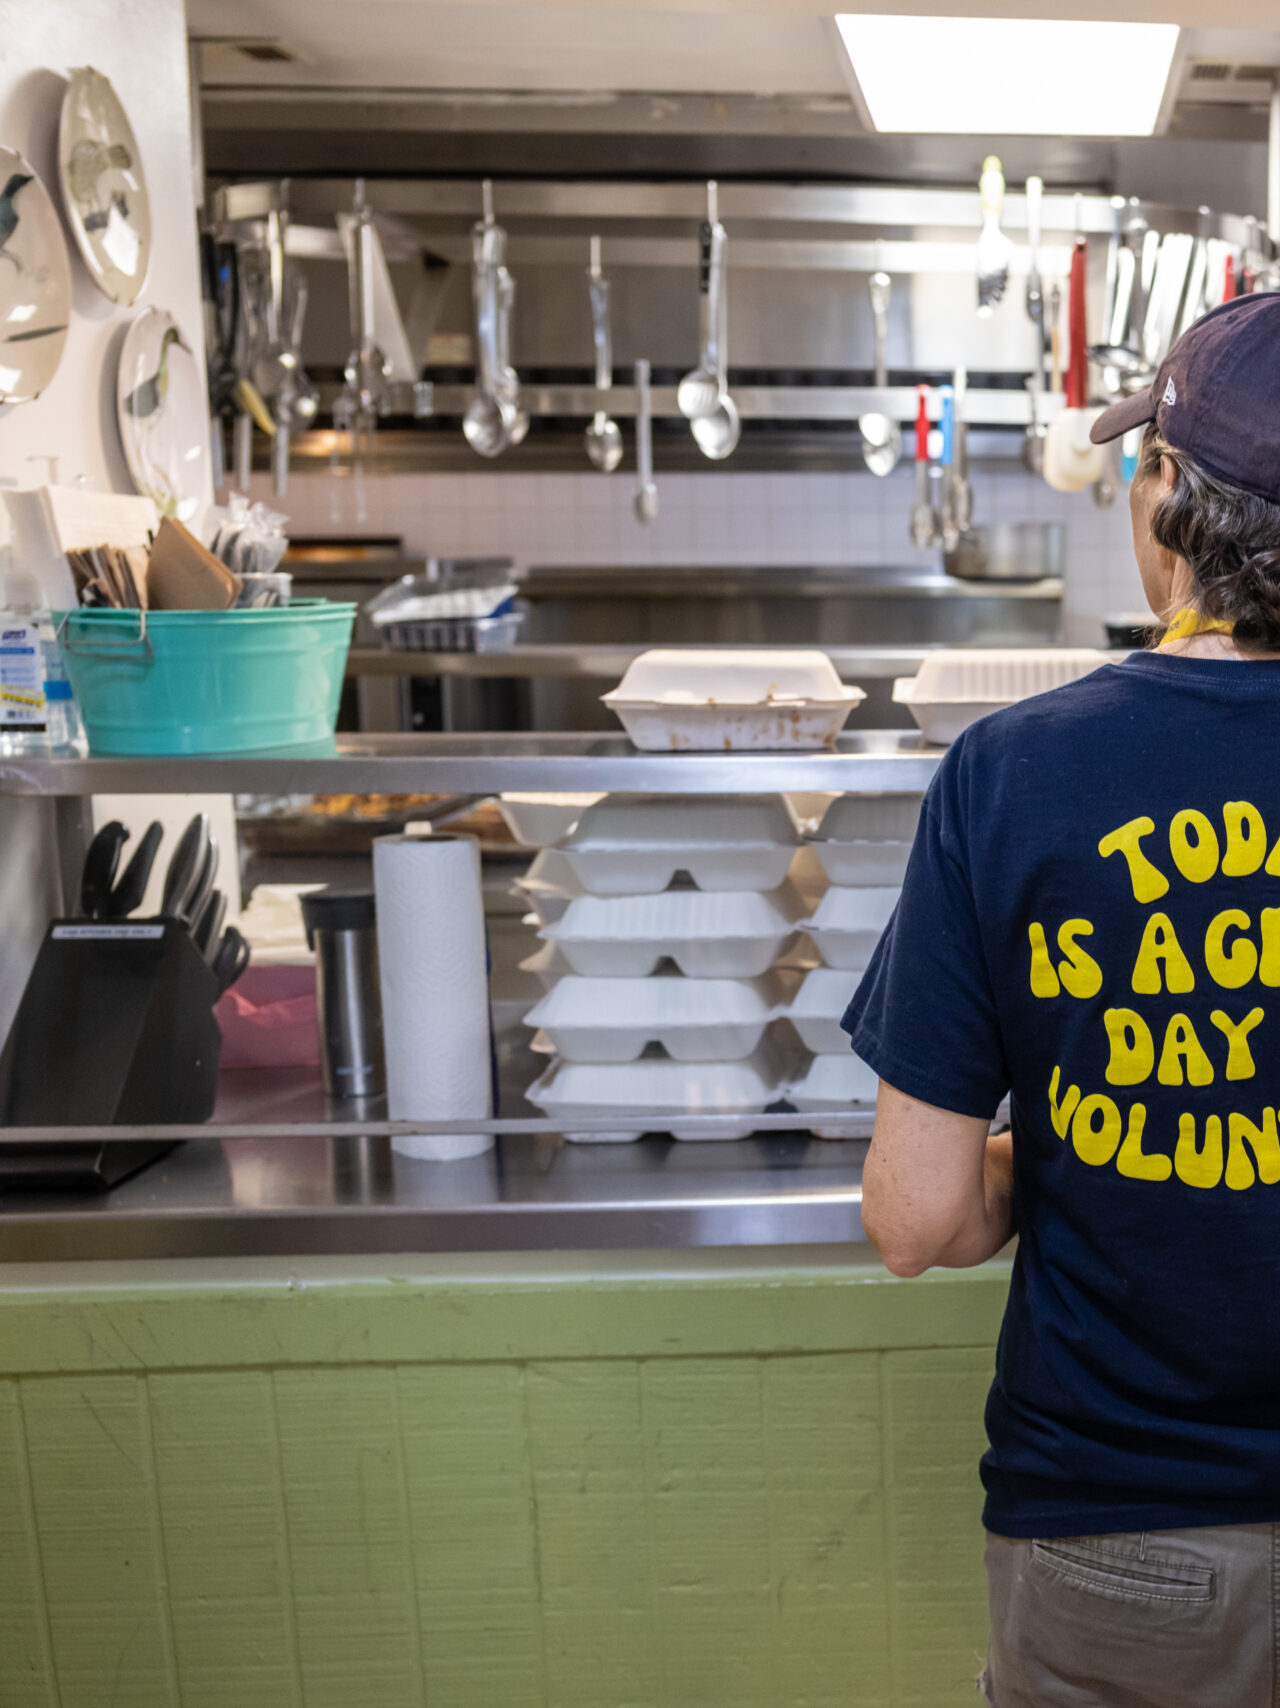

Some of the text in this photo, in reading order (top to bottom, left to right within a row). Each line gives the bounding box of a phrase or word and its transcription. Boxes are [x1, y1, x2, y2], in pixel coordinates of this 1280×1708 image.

[1029, 918, 1103, 999] IS
[1132, 912, 1195, 995] A
[1104, 1007, 1265, 1087] DAY
